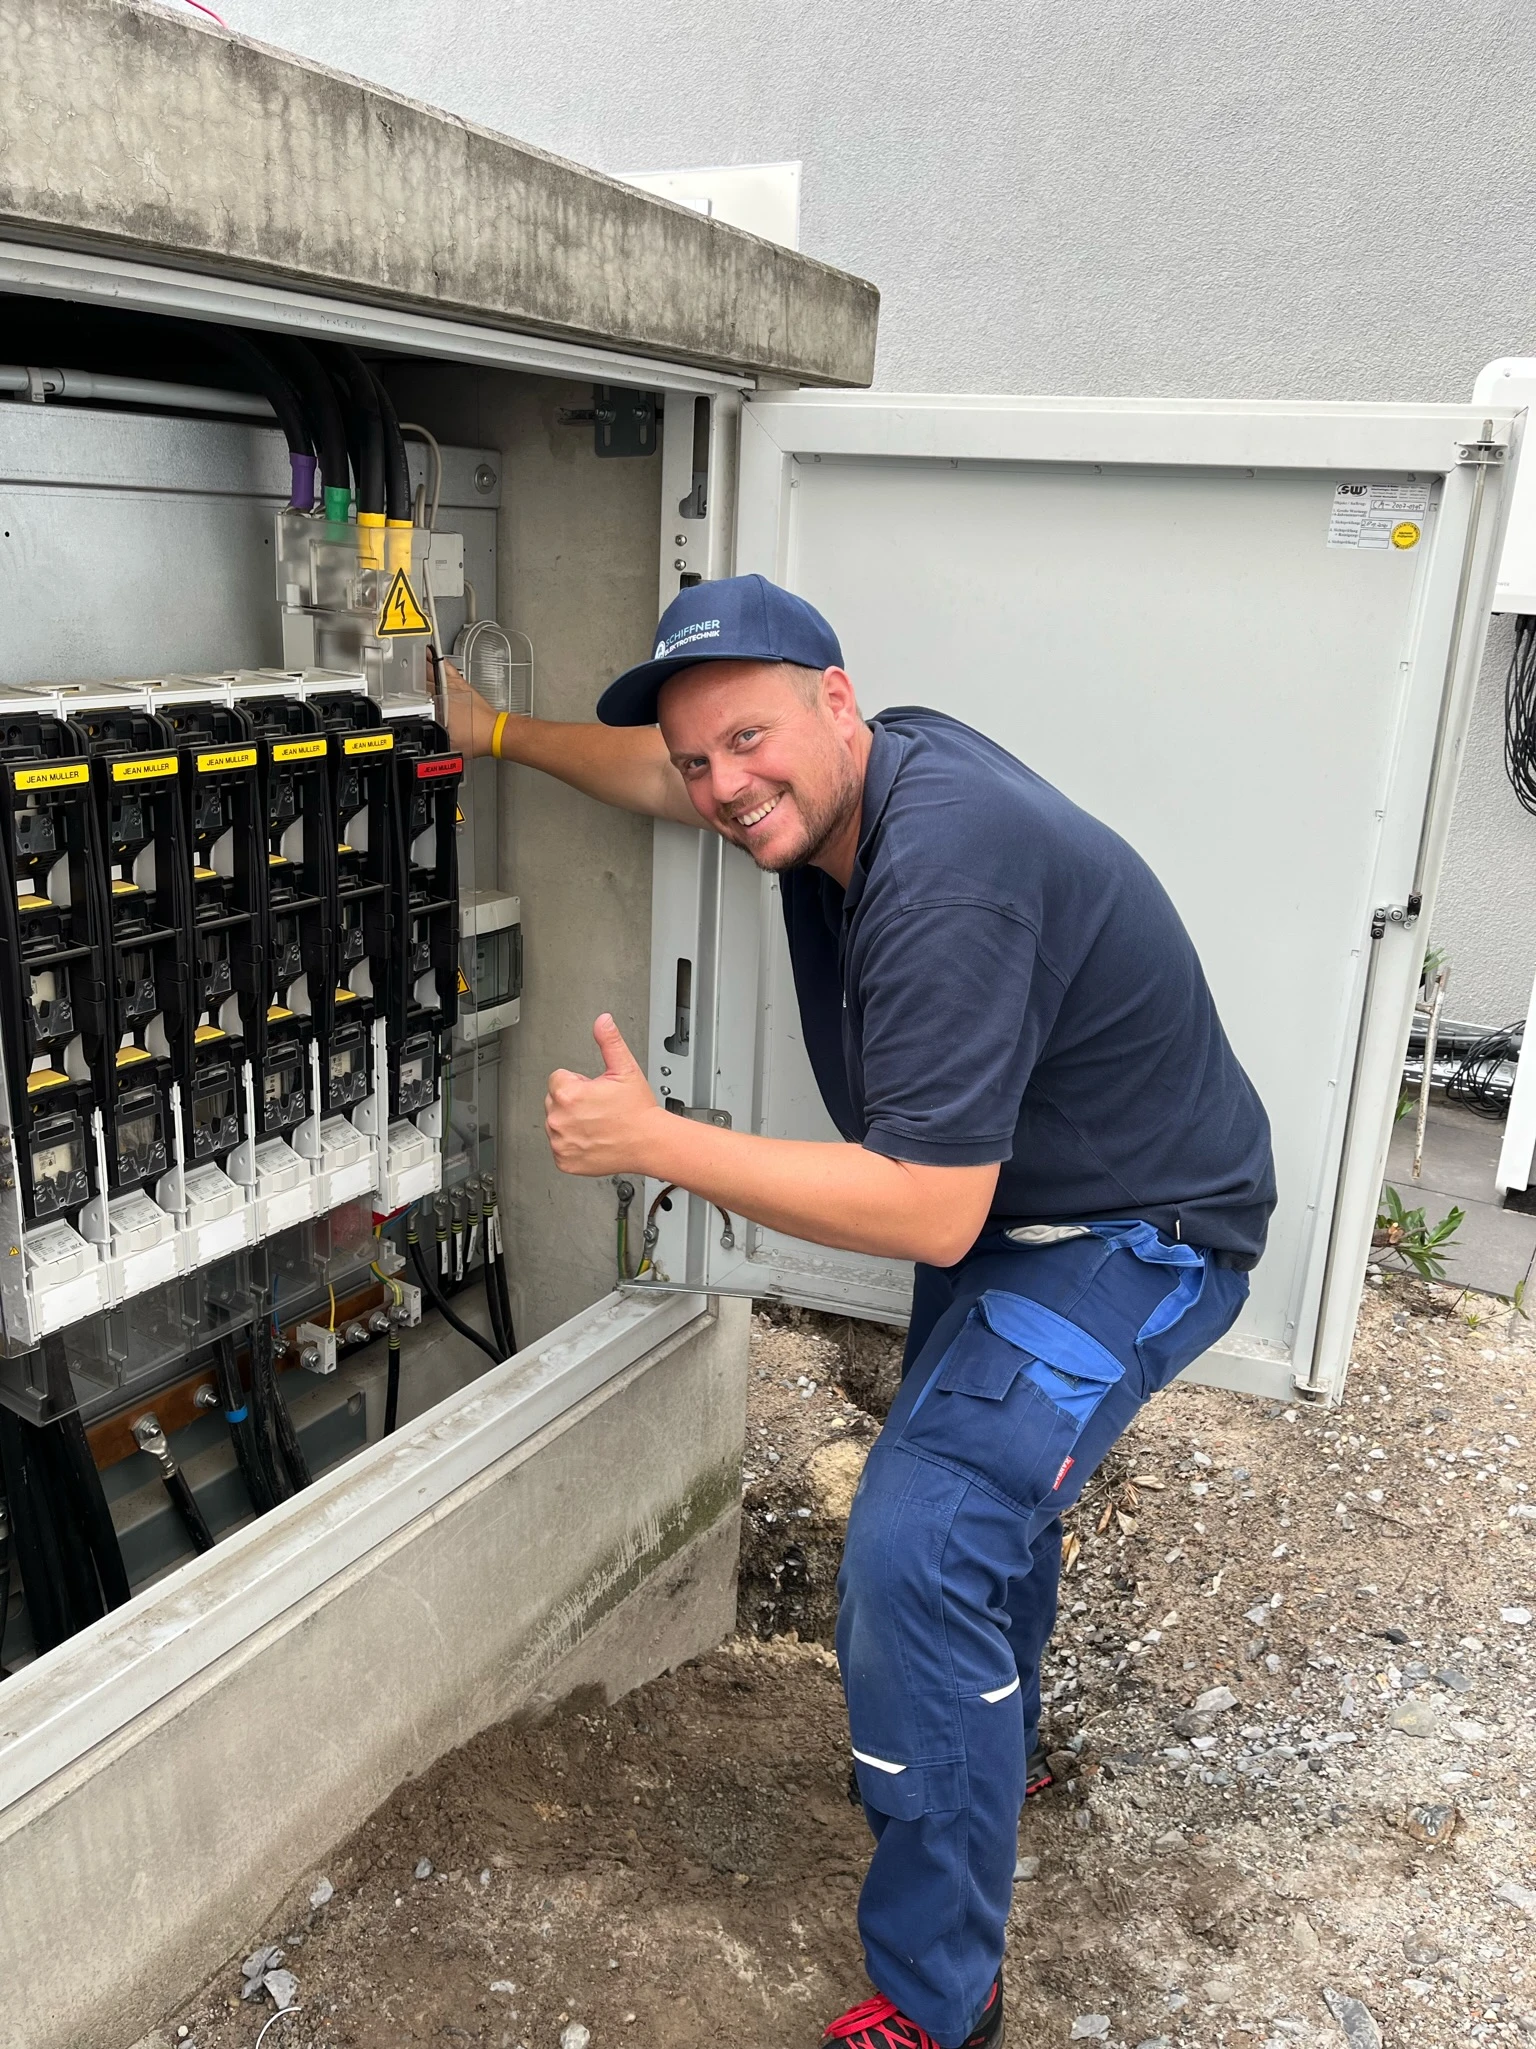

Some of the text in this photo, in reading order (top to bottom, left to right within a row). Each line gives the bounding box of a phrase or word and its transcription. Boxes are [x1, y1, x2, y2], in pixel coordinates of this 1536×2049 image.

[665, 619, 720, 647] SCHIFFNER
[664, 630, 720, 656] ELEKTROTECHNIK
[282, 748, 297, 756] JEAN
[206, 757, 223, 766] JEAN
[122, 767, 142, 775] JEAN
[26, 775, 47, 783] JEAN
